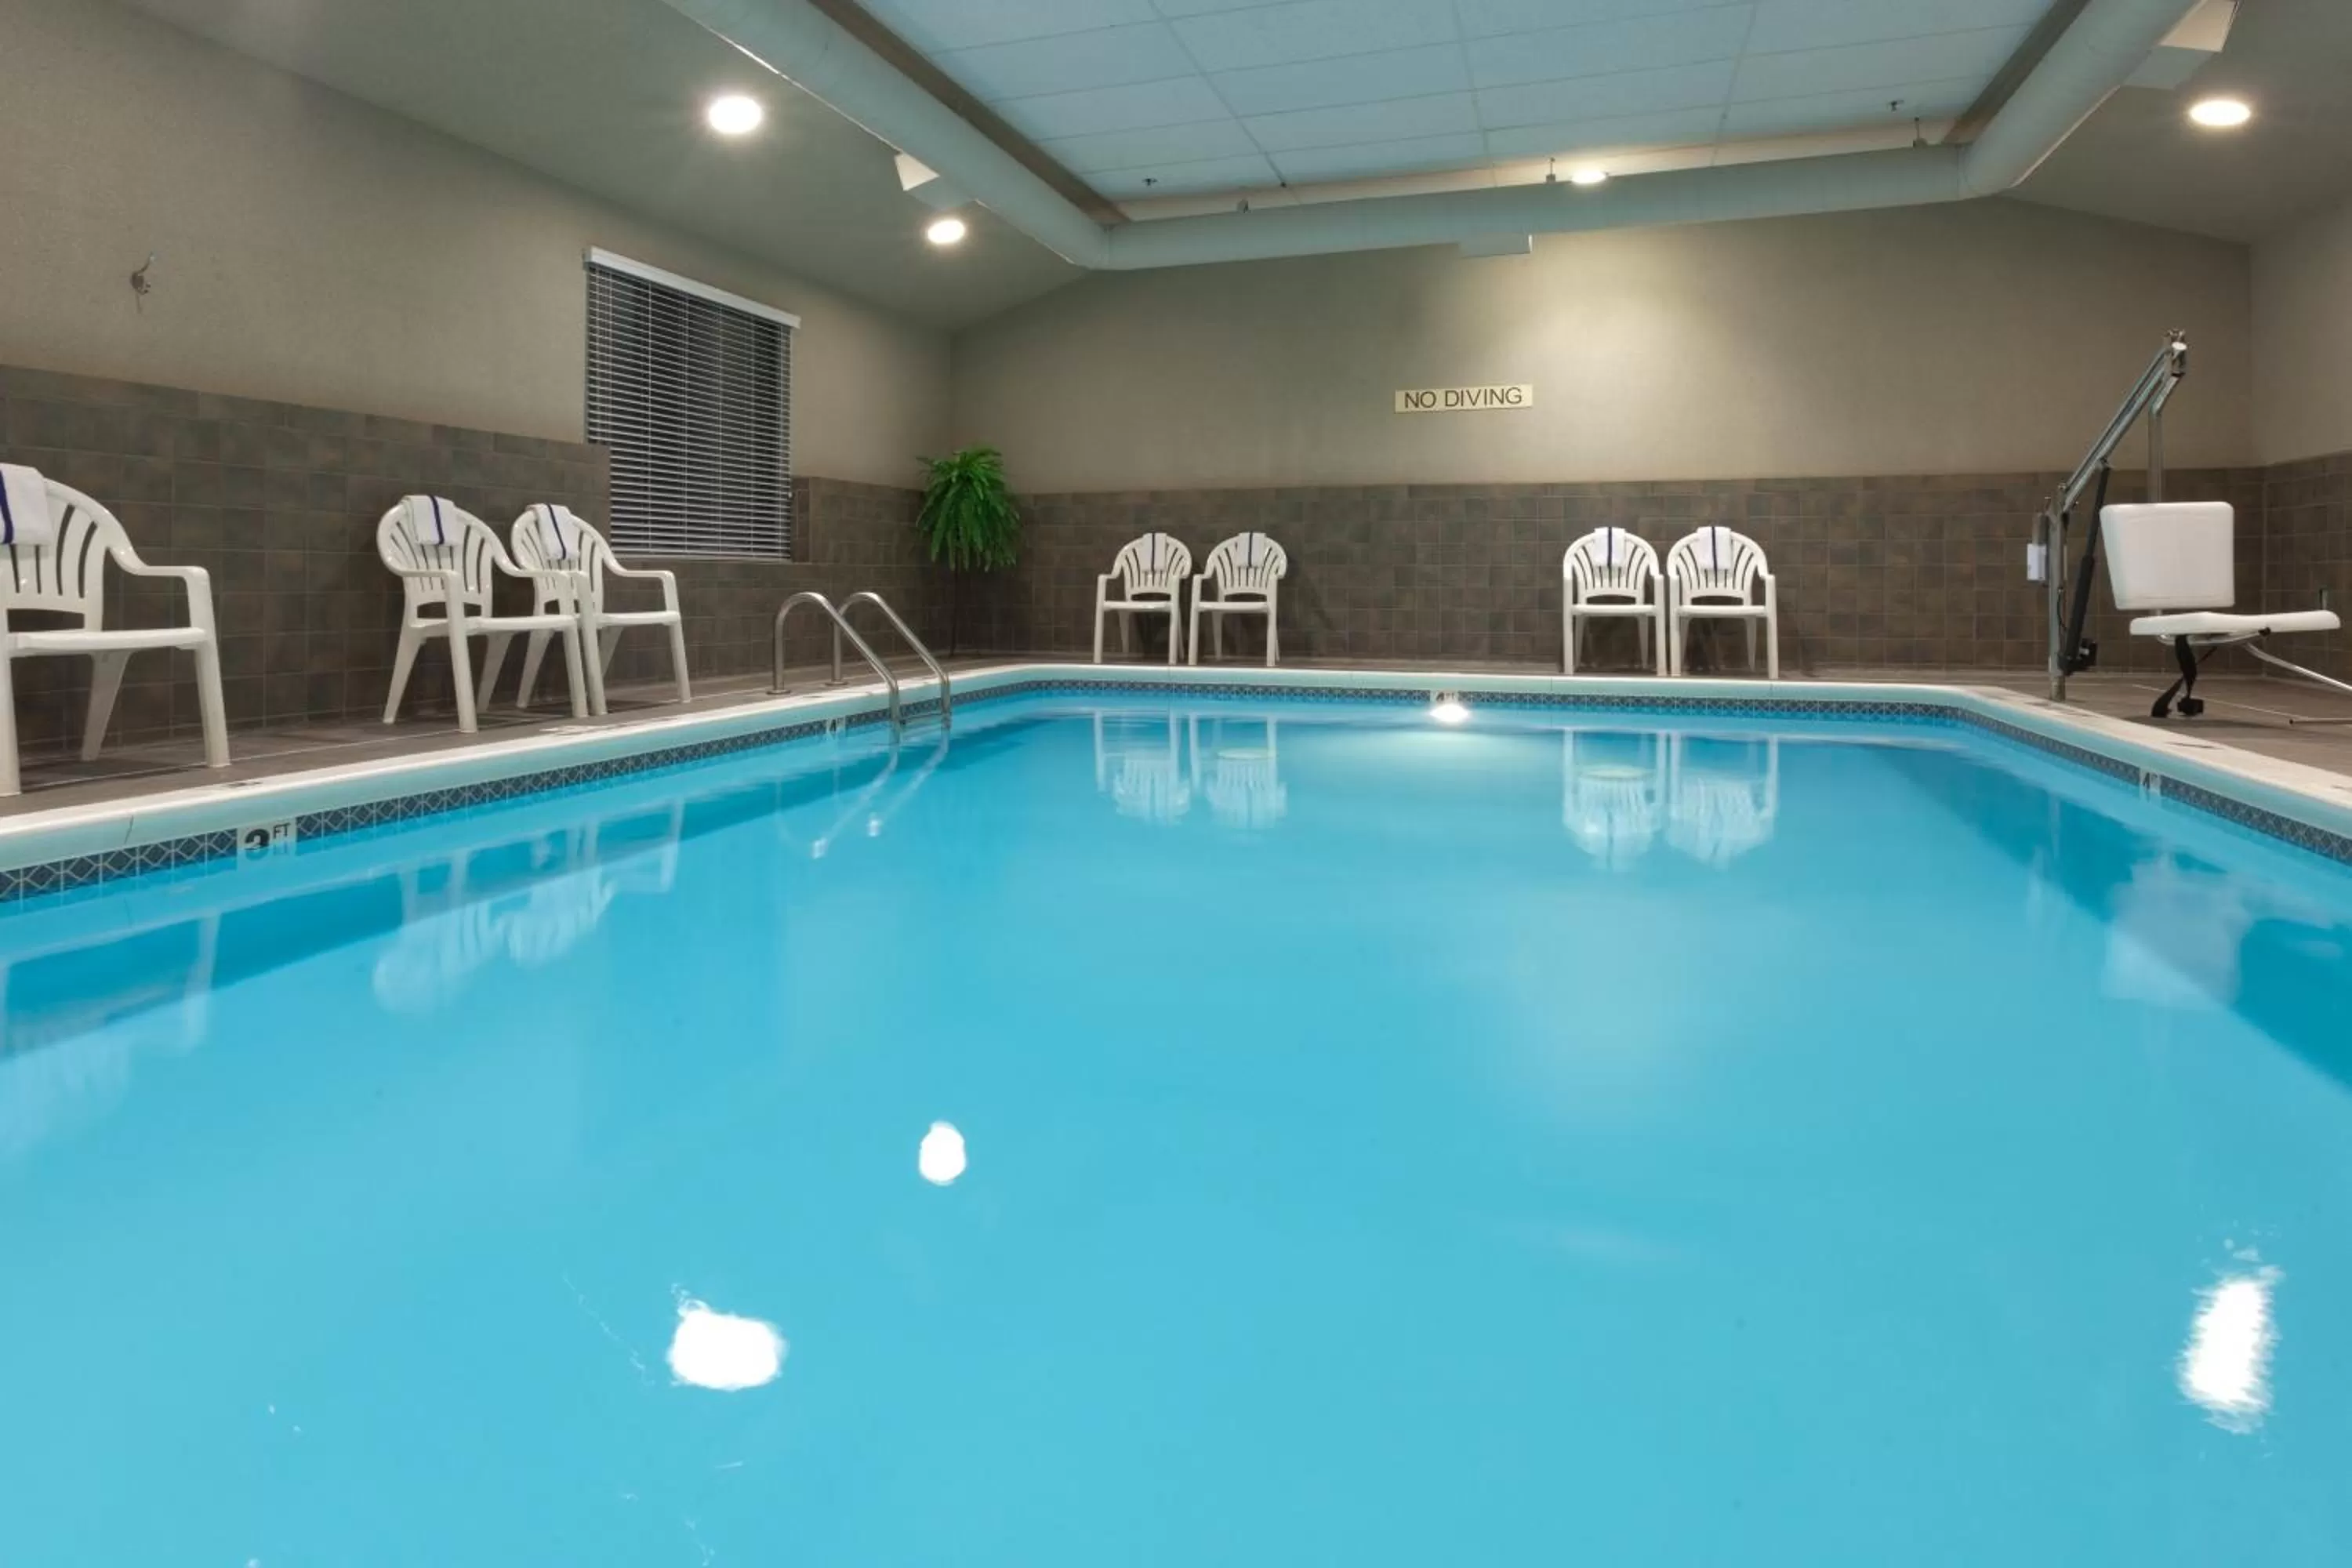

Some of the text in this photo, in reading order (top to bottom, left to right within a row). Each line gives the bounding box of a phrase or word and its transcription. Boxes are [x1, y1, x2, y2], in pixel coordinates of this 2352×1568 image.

[1404, 387, 1523, 408] NO DIVING
[273, 822, 290, 840] FT
